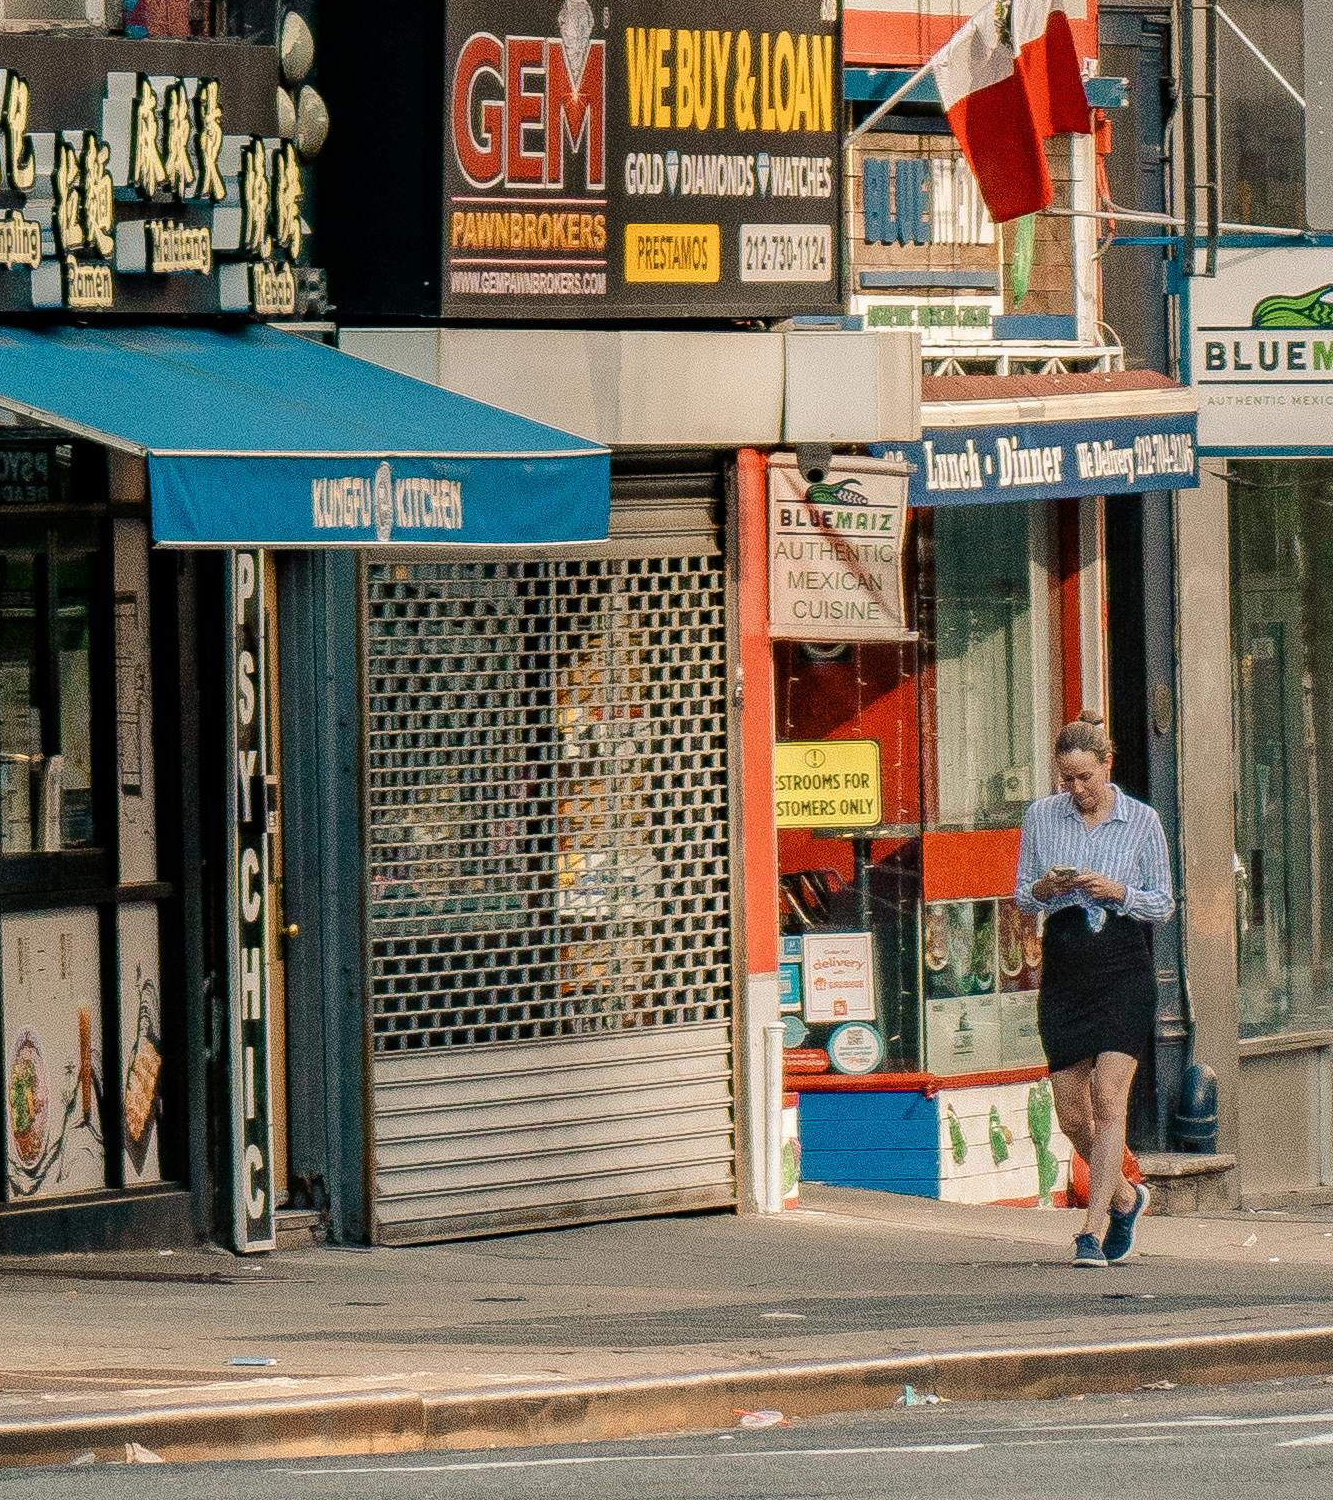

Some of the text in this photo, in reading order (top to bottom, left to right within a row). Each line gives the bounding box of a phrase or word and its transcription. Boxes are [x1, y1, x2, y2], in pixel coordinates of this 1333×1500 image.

[625, 27, 833, 133] WE BUY & LOAN
[452, 31, 607, 191] GEM
[625, 152, 832, 198] GOLD DIAMONDS WATCHES
[451, 211, 607, 251] PAWNBROKERS
[636, 235, 827, 272] PRESTAMOS 212-730-1124
[66, 254, 115, 308] Ramen
[1208, 395, 1287, 406] AUTHENTIC
[923, 438, 983, 491] Lunch
[997, 436, 1063, 487] Dinner
[1076, 442, 1095, 479] We
[1093, 438, 1134, 484] Delivery
[311, 474, 464, 531] KUNGFU KITCHEN
[779, 508, 893, 532] BLUEMAIZ
[774, 540, 894, 564] AUTHENTIC
[788, 570, 883, 592] MEXICAN
[792, 600, 880, 621] CUISINE
[844, 772, 870, 790] FOR
[841, 798, 874, 815] ONLY
[236, 551, 266, 1221] PSYCHIC
